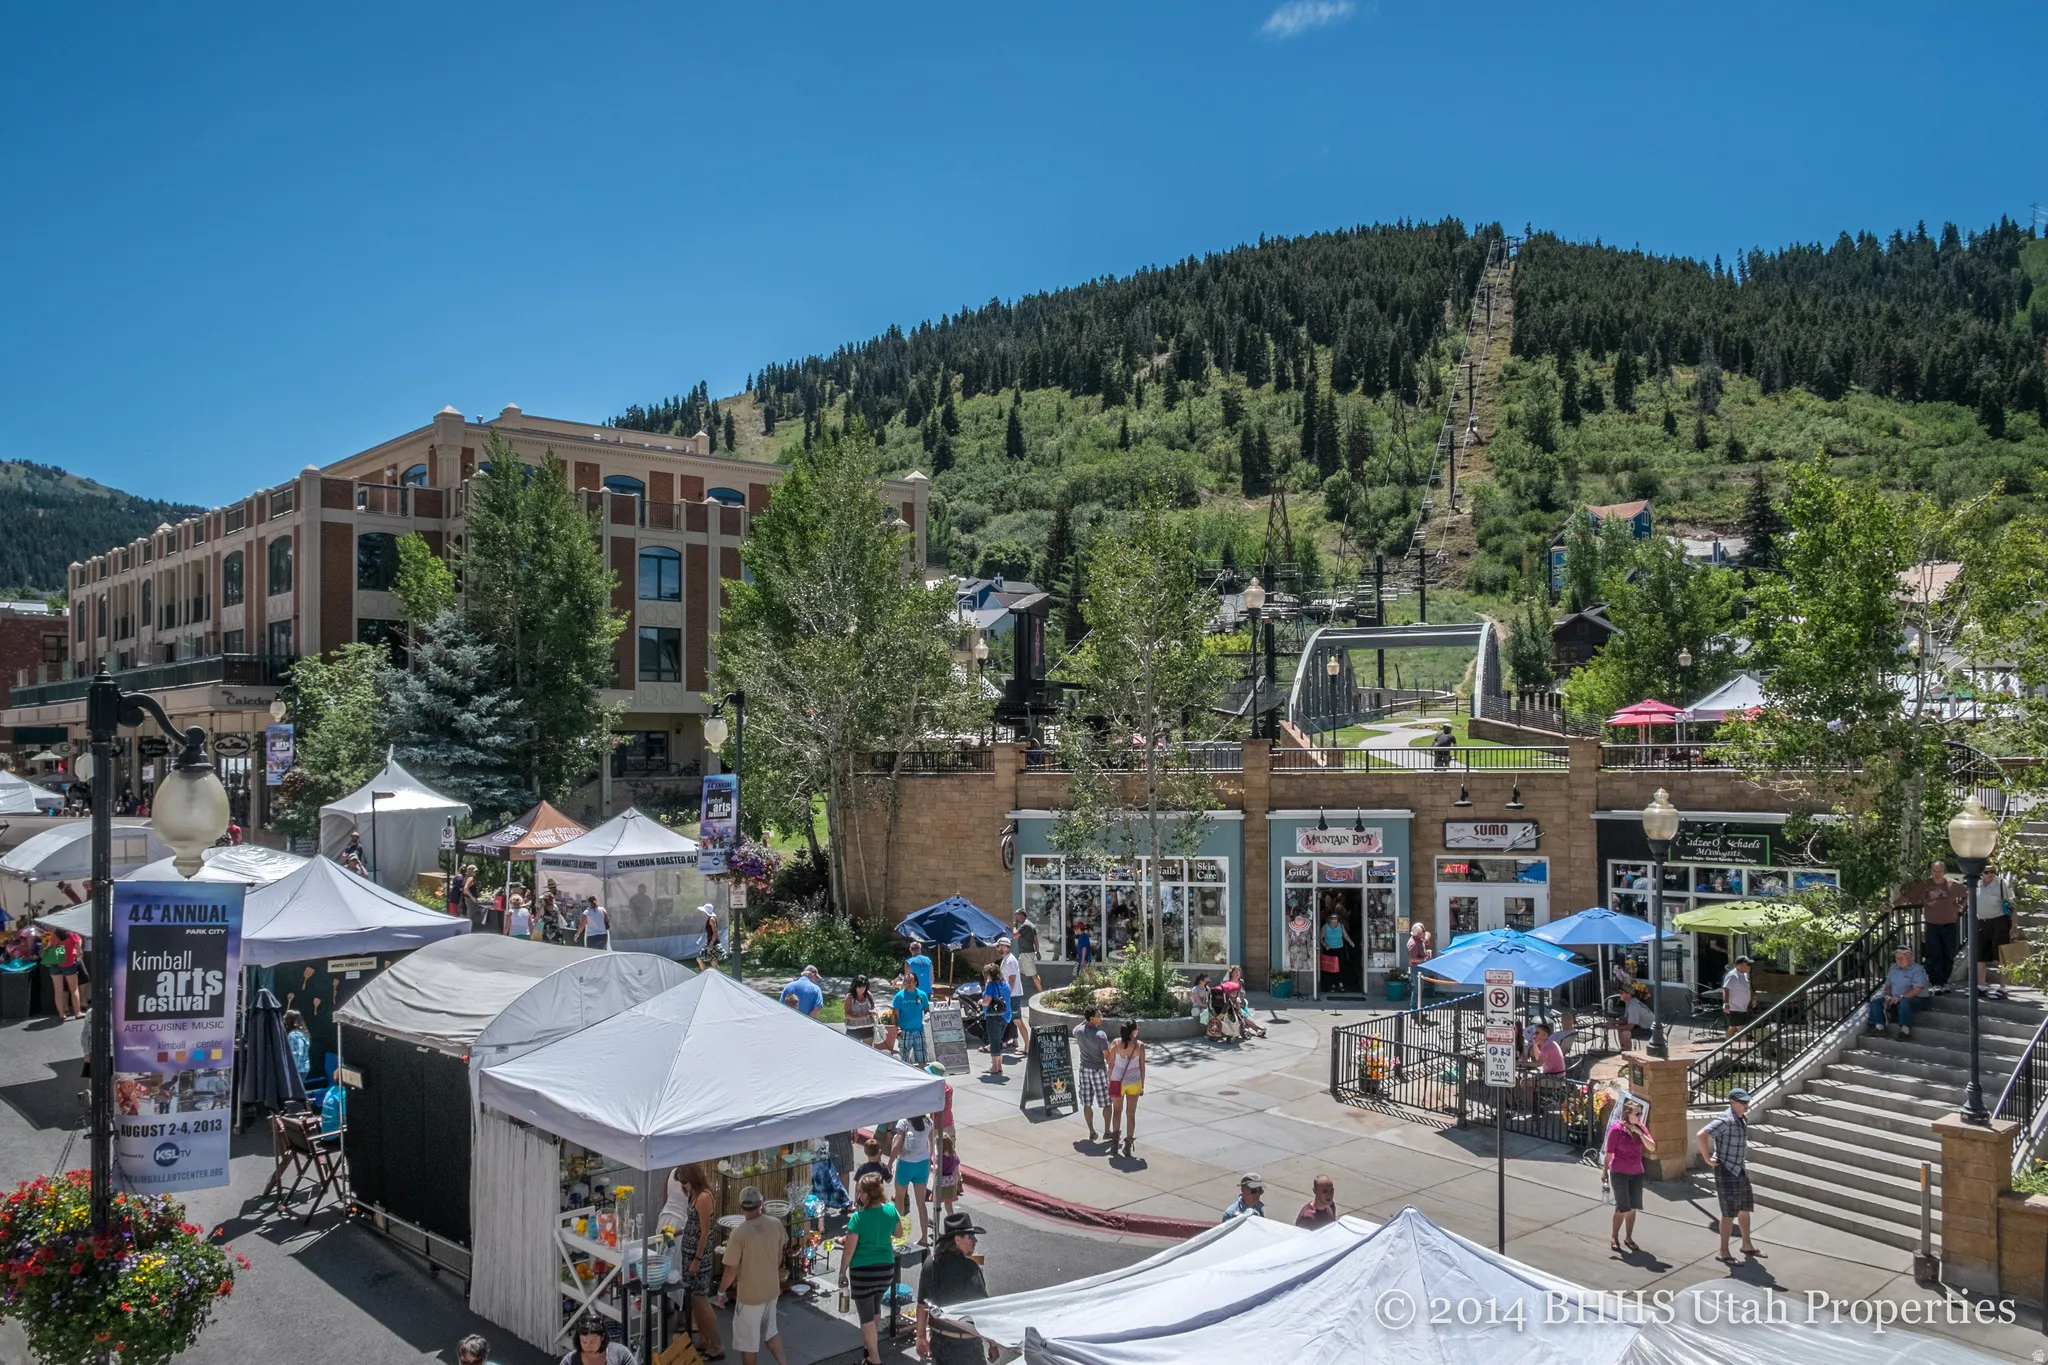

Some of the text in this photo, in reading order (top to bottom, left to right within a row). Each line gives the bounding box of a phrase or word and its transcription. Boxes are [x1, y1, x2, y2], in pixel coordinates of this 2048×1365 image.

[713, 802, 730, 812] arts
[534, 828, 555, 838] THINK
[1474, 824, 1508, 836] SUMO
[528, 834, 559, 844] THINK
[1305, 834, 1373, 846] MOUNTAIN BODY
[618, 858, 655, 868] CINNAMON
[656, 856, 686, 866] ROASTED
[1197, 862, 1216, 871] Skin
[1289, 868, 1309, 876] Gifts
[1326, 868, 1354, 880] OPEN
[1444, 864, 1469, 873] ATM
[1197, 871, 1217, 880] Care
[161, 904, 229, 922] ANNUAL
[132, 950, 192, 970] kimball
[157, 968, 223, 996] arts
[138, 994, 210, 1012] festival
[124, 1021, 224, 1033] ART CUISINE MUSIC
[158, 1041, 186, 1050] kimball
[196, 1040, 223, 1048] center
[1049, 1092, 1072, 1101] SAPPORO
[121, 1119, 222, 1137] AUGUST 2-4, 2013
[155, 1149, 179, 1160] KSL
